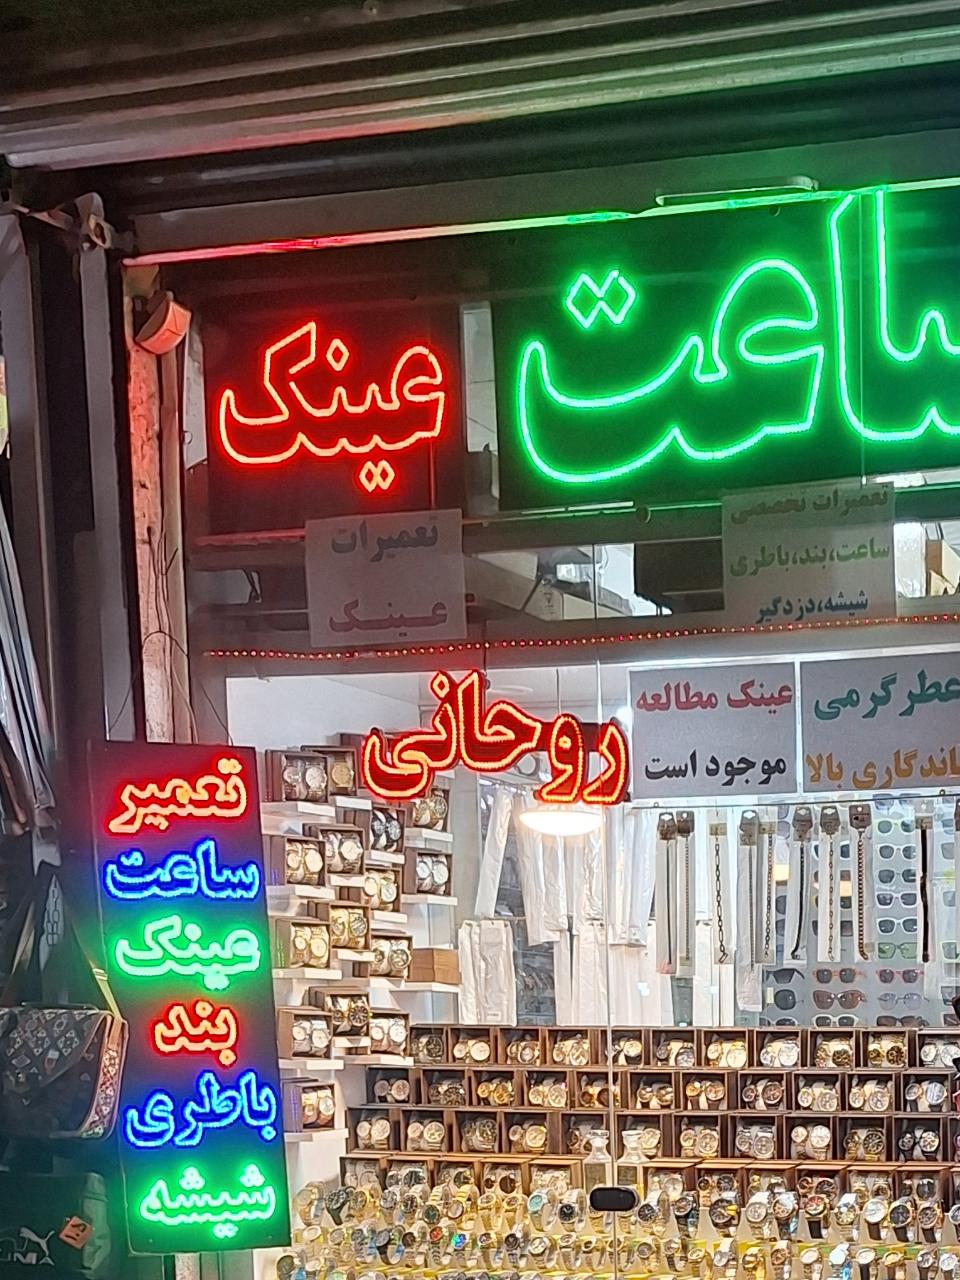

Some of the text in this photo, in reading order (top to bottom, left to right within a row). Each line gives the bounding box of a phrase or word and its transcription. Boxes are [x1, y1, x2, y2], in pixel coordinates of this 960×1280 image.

[218, 321, 447, 493] عینک
[812, 481, 889, 516] تعمیرات
[331, 515, 439, 562] تعمیرات
[329, 599, 448, 637] عینک
[636, 677, 793, 714] عینک مطالعه
[813, 672, 898, 721] گرمی
[362, 670, 630, 803] روحانی
[644, 749, 787, 787] موجود است
[107, 756, 248, 834] تعمیر
[804, 752, 844, 789] بالا
[104, 838, 261, 901] ساعت
[114, 914, 261, 990] عینک
[153, 999, 238, 1066] بند
[126, 1070, 278, 1148] باطری
[138, 1163, 277, 1240] شیشه
